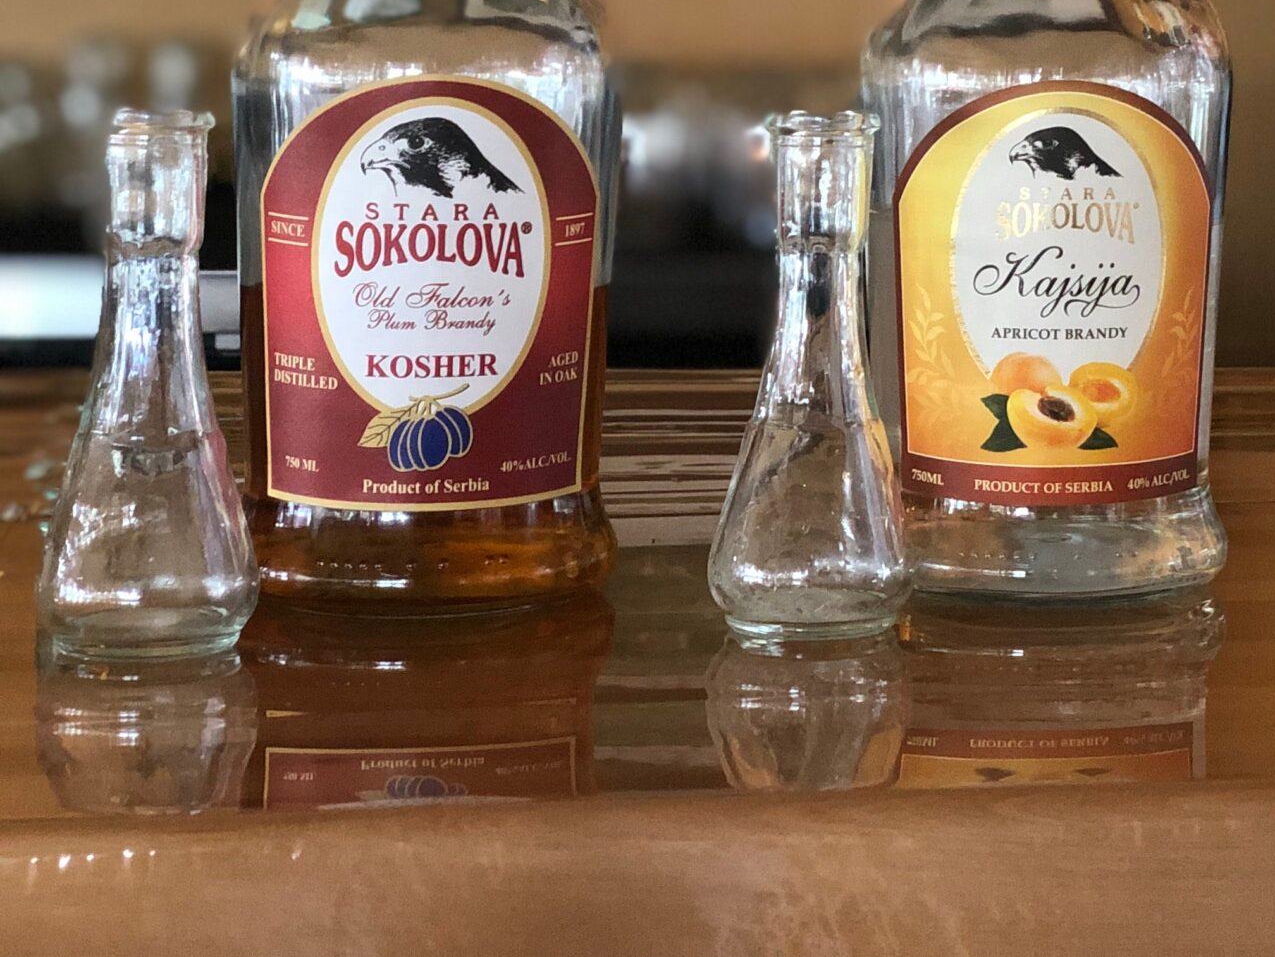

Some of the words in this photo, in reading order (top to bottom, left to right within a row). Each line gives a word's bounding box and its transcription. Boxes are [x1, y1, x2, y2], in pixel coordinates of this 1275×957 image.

[1018, 186, 1116, 201] STARA
[366, 202, 499, 221] STARA
[271, 221, 305, 238] SINCE
[564, 222, 585, 238] 1897
[973, 246, 1141, 318] Kajsija
[353, 282, 400, 309] Old
[405, 282, 511, 309] Falcon's
[367, 309, 416, 331] Plum
[424, 308, 496, 336] Brandy
[991, 327, 1061, 340] APRICOT
[1065, 327, 1128, 340] BRANDY
[274, 352, 315, 372] TRIPLE
[366, 353, 499, 379] KOSHER
[548, 351, 579, 368] AGED
[274, 370, 338, 390] DISTILLED
[540, 370, 553, 385] IN
[555, 367, 577, 383] OAK
[285, 455, 300, 469] 750
[301, 457, 320, 472] ML
[911, 468, 945, 486] 750ML
[1126, 476, 1150, 490] 40%
[362, 479, 421, 494] Product
[424, 480, 441, 493] of
[443, 478, 489, 493] Serbia
[974, 479, 1042, 494] PRODUCT
[1044, 482, 1063, 494] OF
[1065, 480, 1113, 493] SERBIA
